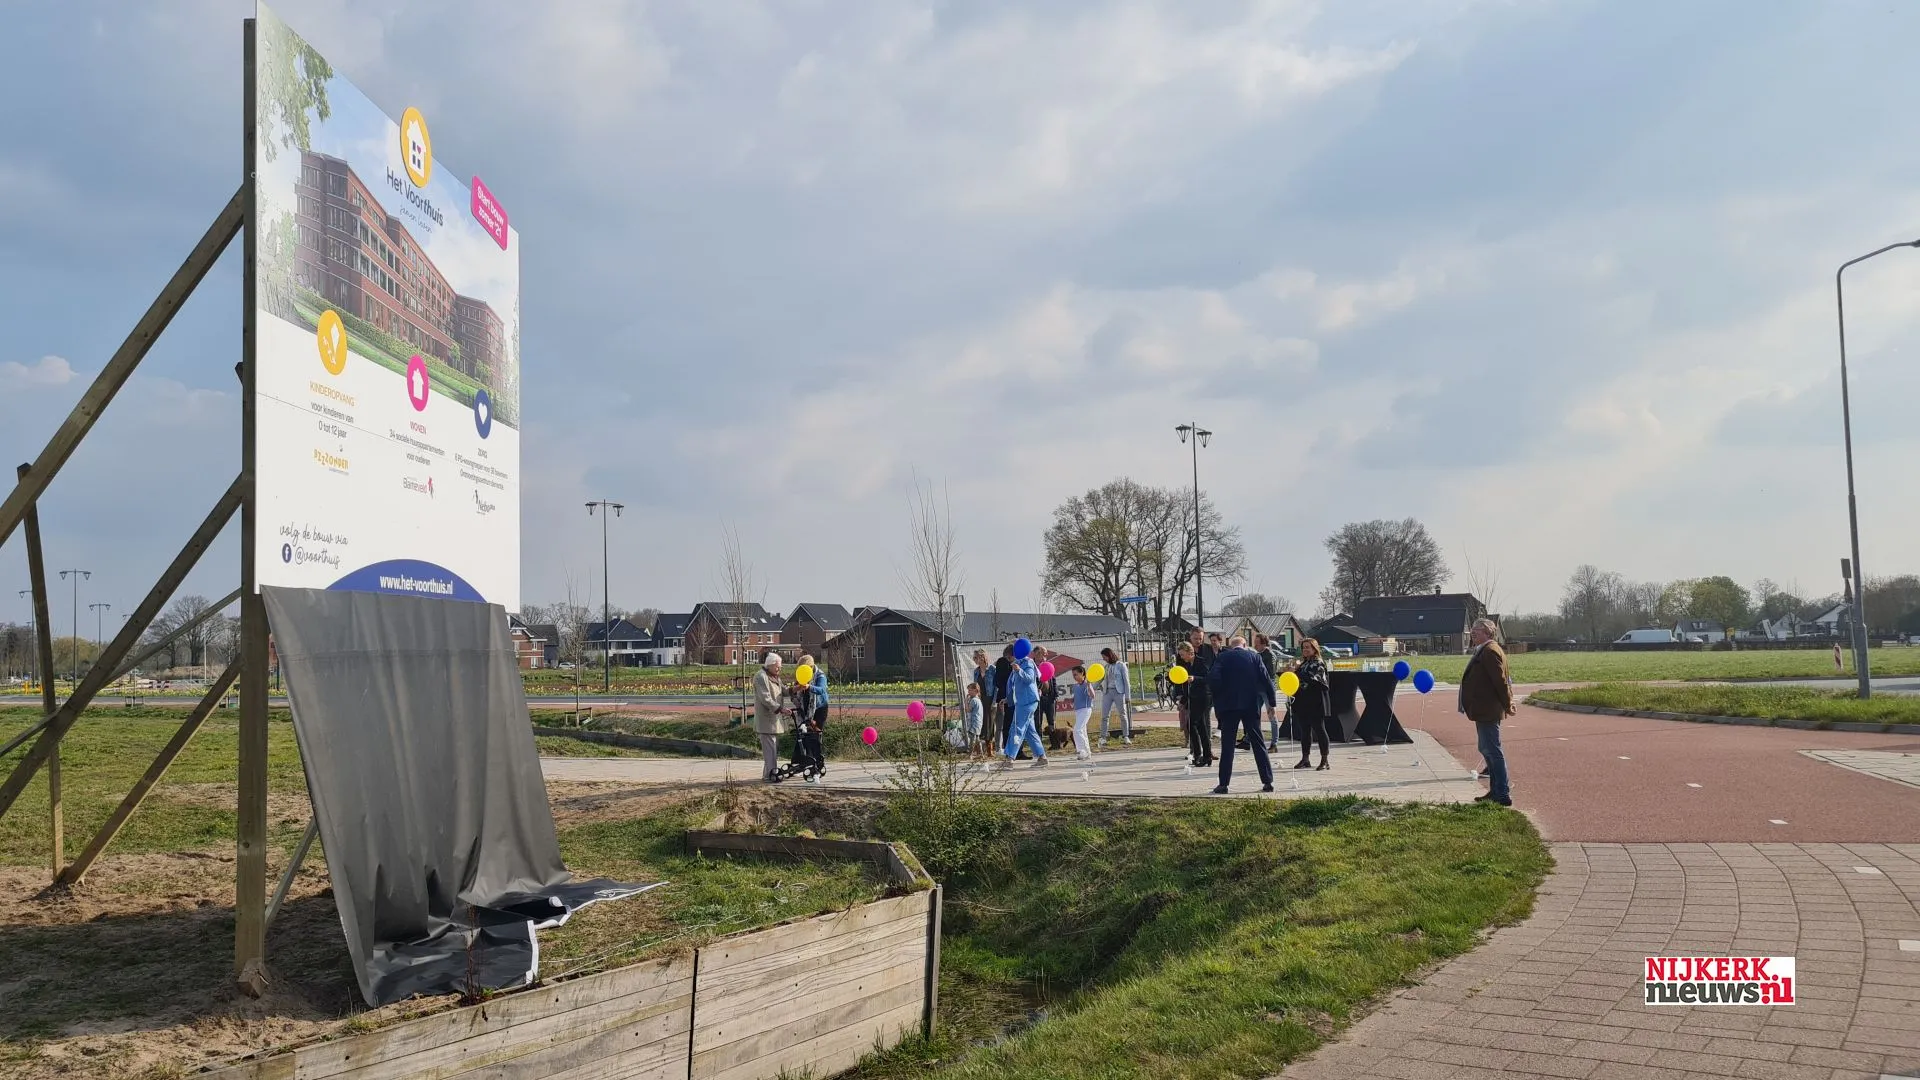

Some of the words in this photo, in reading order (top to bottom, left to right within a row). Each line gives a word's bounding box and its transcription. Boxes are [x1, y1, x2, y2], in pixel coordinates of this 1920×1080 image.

[386, 165, 403, 196] Het
[404, 179, 444, 227] Voorthuis
[477, 185, 491, 211] Start
[490, 200, 504, 227] bouw
[309, 379, 355, 407] KINDEROPVANG
[311, 401, 323, 412] voor
[323, 403, 345, 421] kinderen
[345, 414, 355, 424] van
[318, 419, 323, 431] 0
[323, 422, 331, 434] tot
[331, 424, 338, 436] 12
[337, 426, 347, 439] jaar
[409, 420, 427, 435] WONEN
[280, 520, 300, 547] volg
[302, 522, 312, 541] de
[313, 525, 333, 544] bouw
[335, 532, 349, 545] via
[294, 546, 341, 570] @voorthuis
[379, 573, 454, 596] www.het-voorthuis.nl
